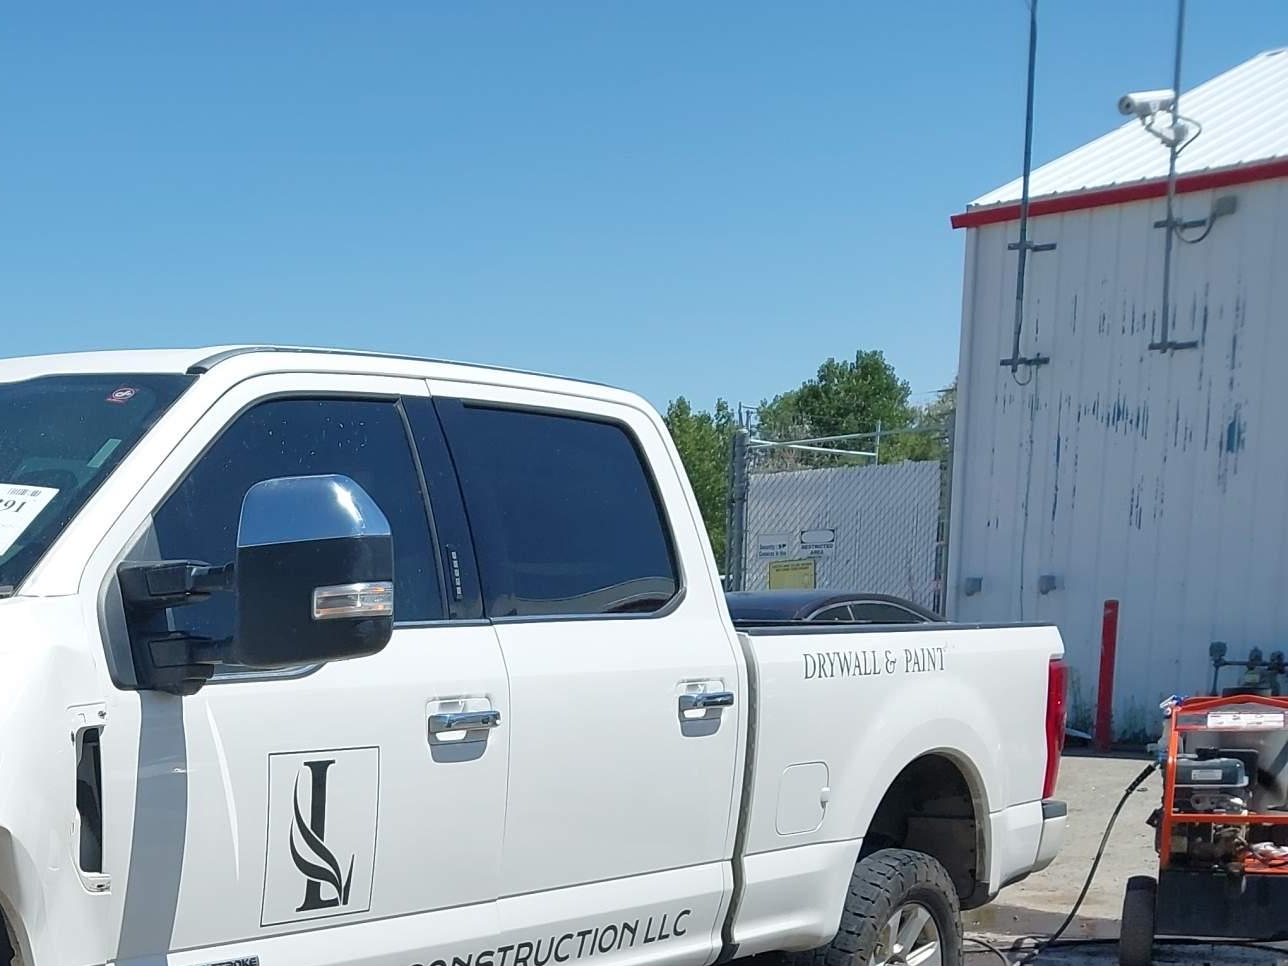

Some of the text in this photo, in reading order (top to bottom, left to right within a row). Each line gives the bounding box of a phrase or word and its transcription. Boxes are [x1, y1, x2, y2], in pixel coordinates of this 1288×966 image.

[803, 648, 947, 679] DRYWALL & PAINT
[643, 909, 692, 944] LLC
